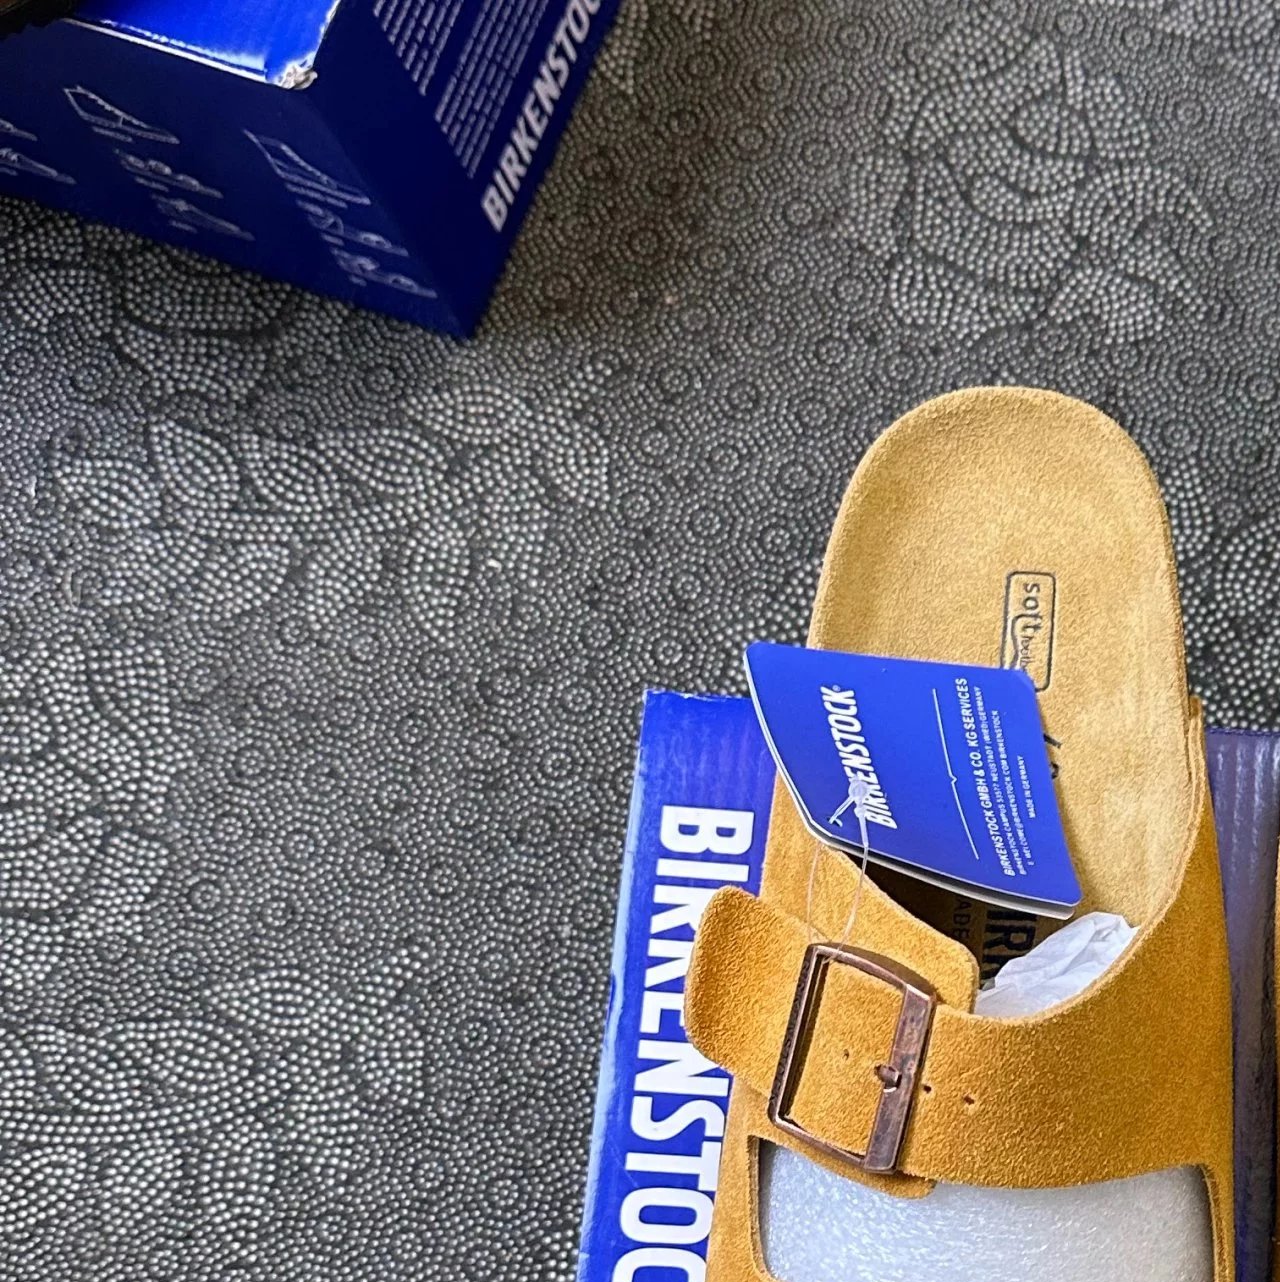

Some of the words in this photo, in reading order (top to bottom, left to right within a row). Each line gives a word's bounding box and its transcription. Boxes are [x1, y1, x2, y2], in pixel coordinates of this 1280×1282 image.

[955, 678, 976, 731] SERVICES
[965, 731, 979, 748] KG
[973, 769, 986, 777] &
[975, 778, 993, 809] GMBH
[983, 809, 1015, 876] BIRKENSTOCK
